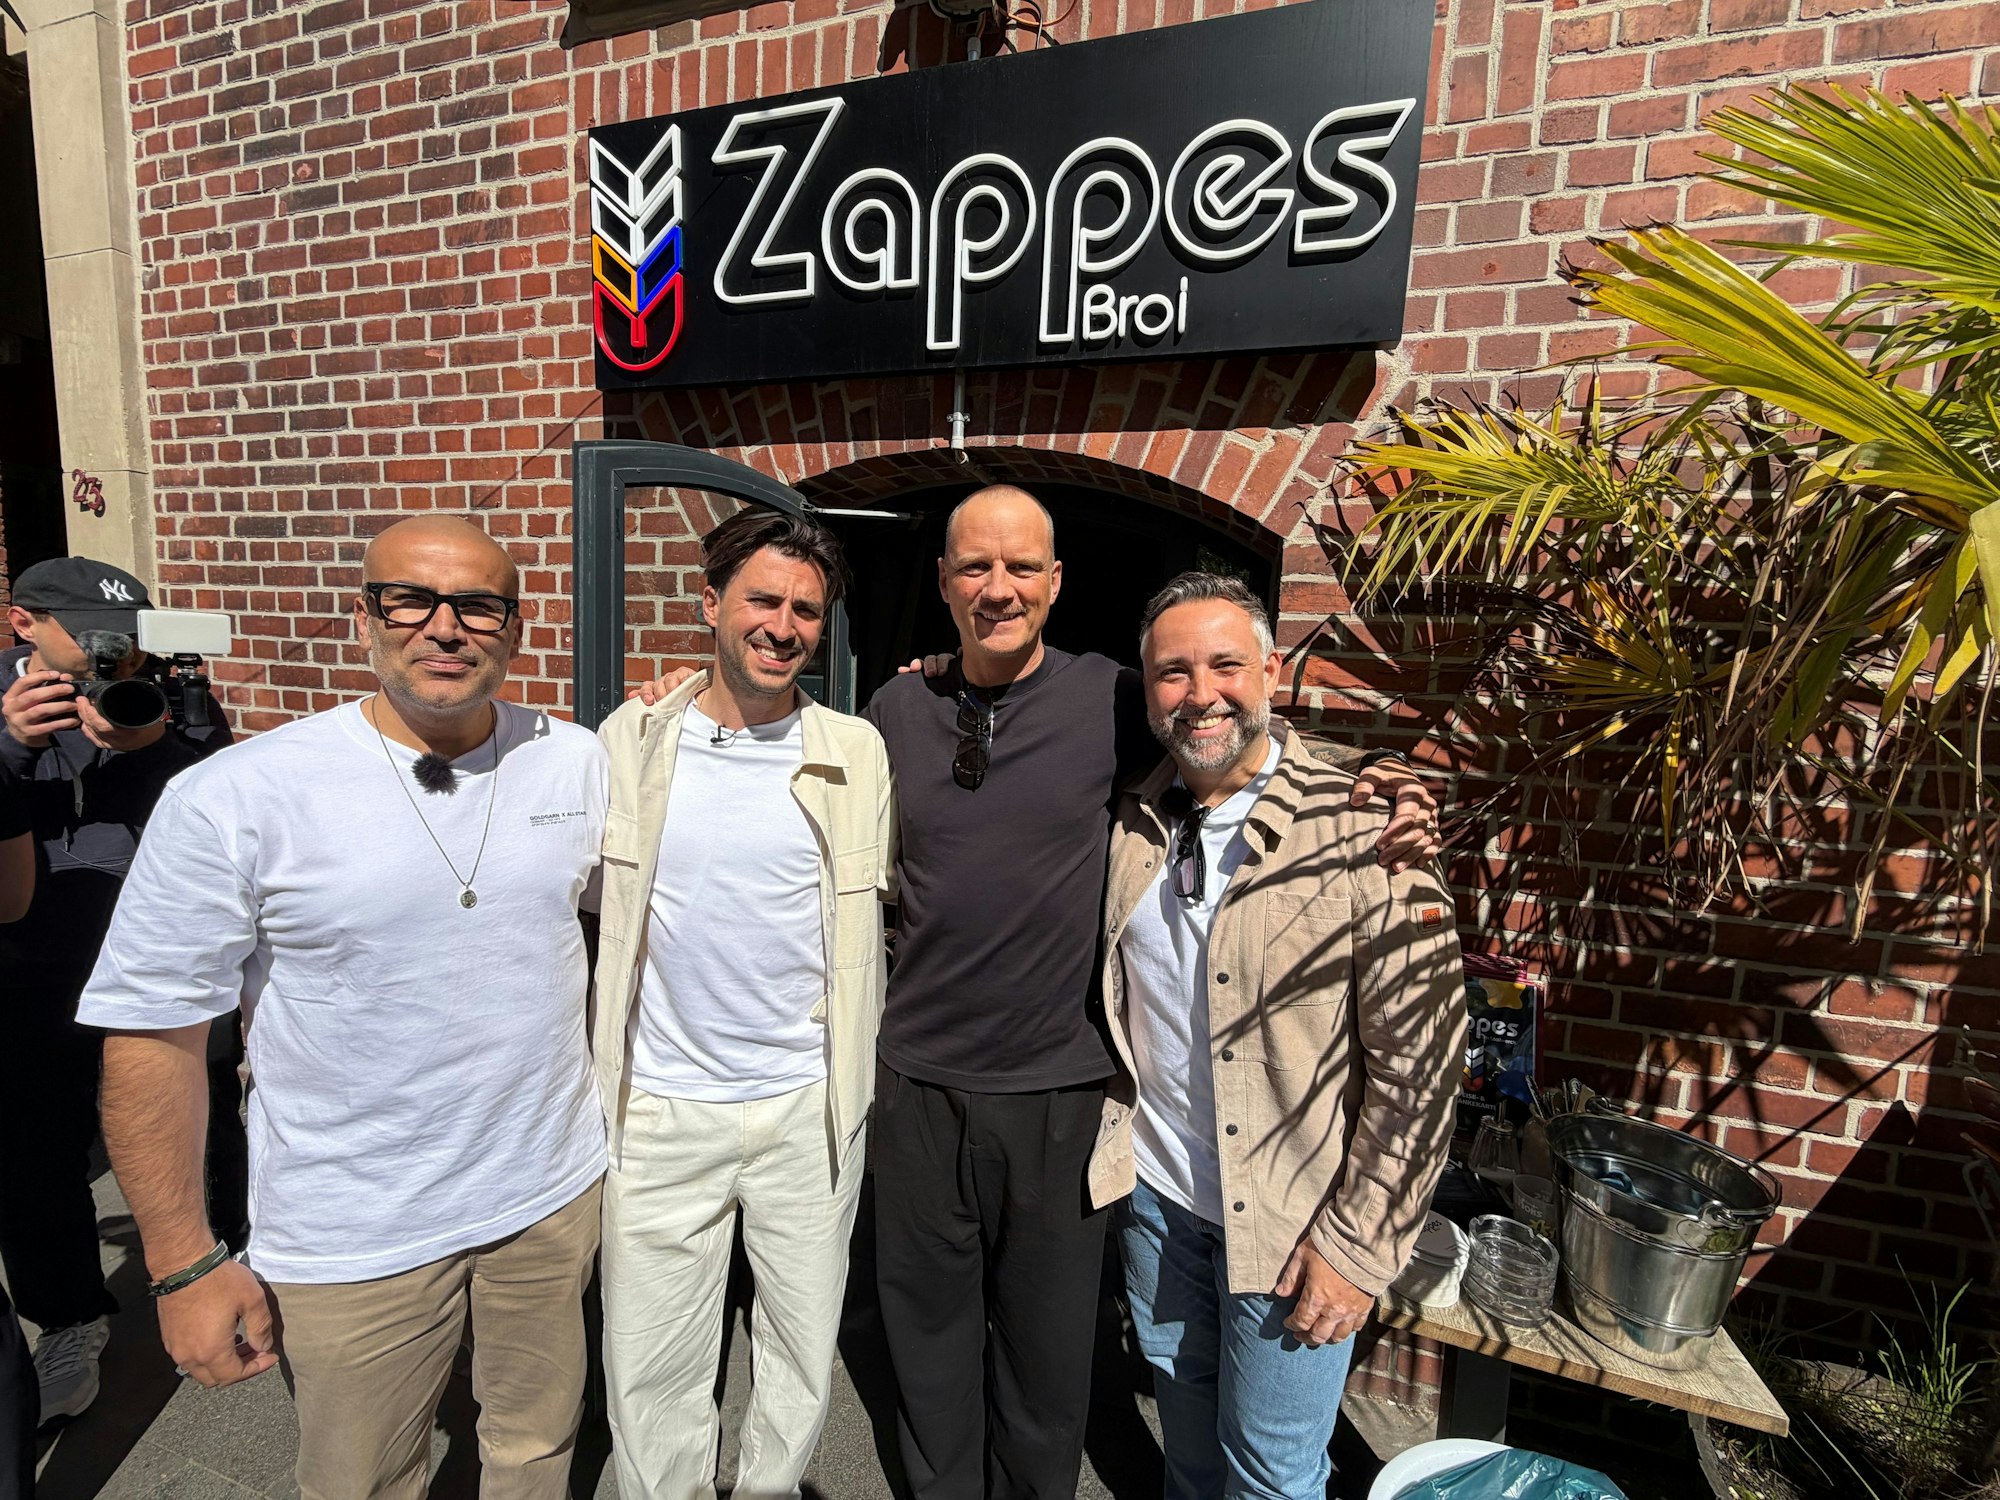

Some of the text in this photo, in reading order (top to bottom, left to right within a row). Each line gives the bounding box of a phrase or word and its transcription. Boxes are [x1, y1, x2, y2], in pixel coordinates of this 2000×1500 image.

[712, 97, 1417, 350] Zappes
[1083, 276, 1188, 340] Broi
[99, 578, 134, 601] NY
